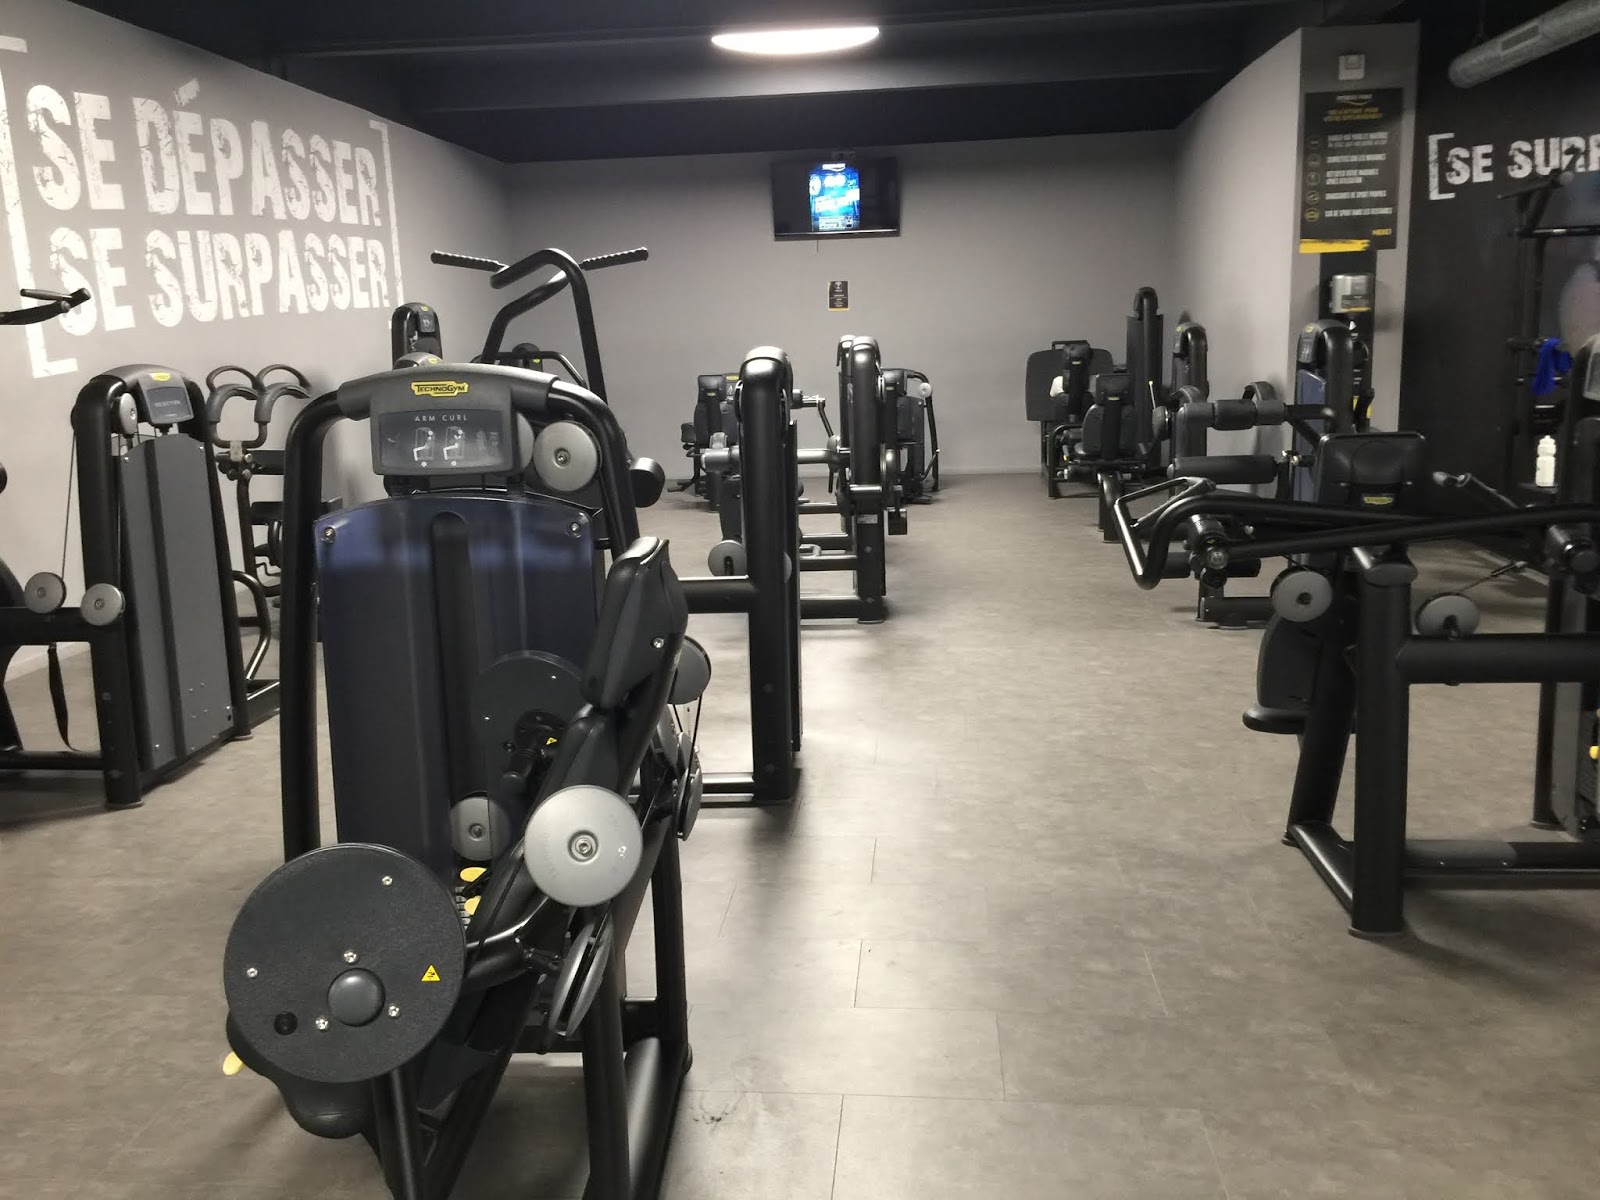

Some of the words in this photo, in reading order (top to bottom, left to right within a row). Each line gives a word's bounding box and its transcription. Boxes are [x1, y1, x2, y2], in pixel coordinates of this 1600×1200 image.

[26, 84, 125, 211] SE
[132, 78, 382, 227] DÉPASSER
[49, 227, 135, 337] SE
[145, 229, 391, 328] SURPASSER
[441, 413, 467, 422] CURL
